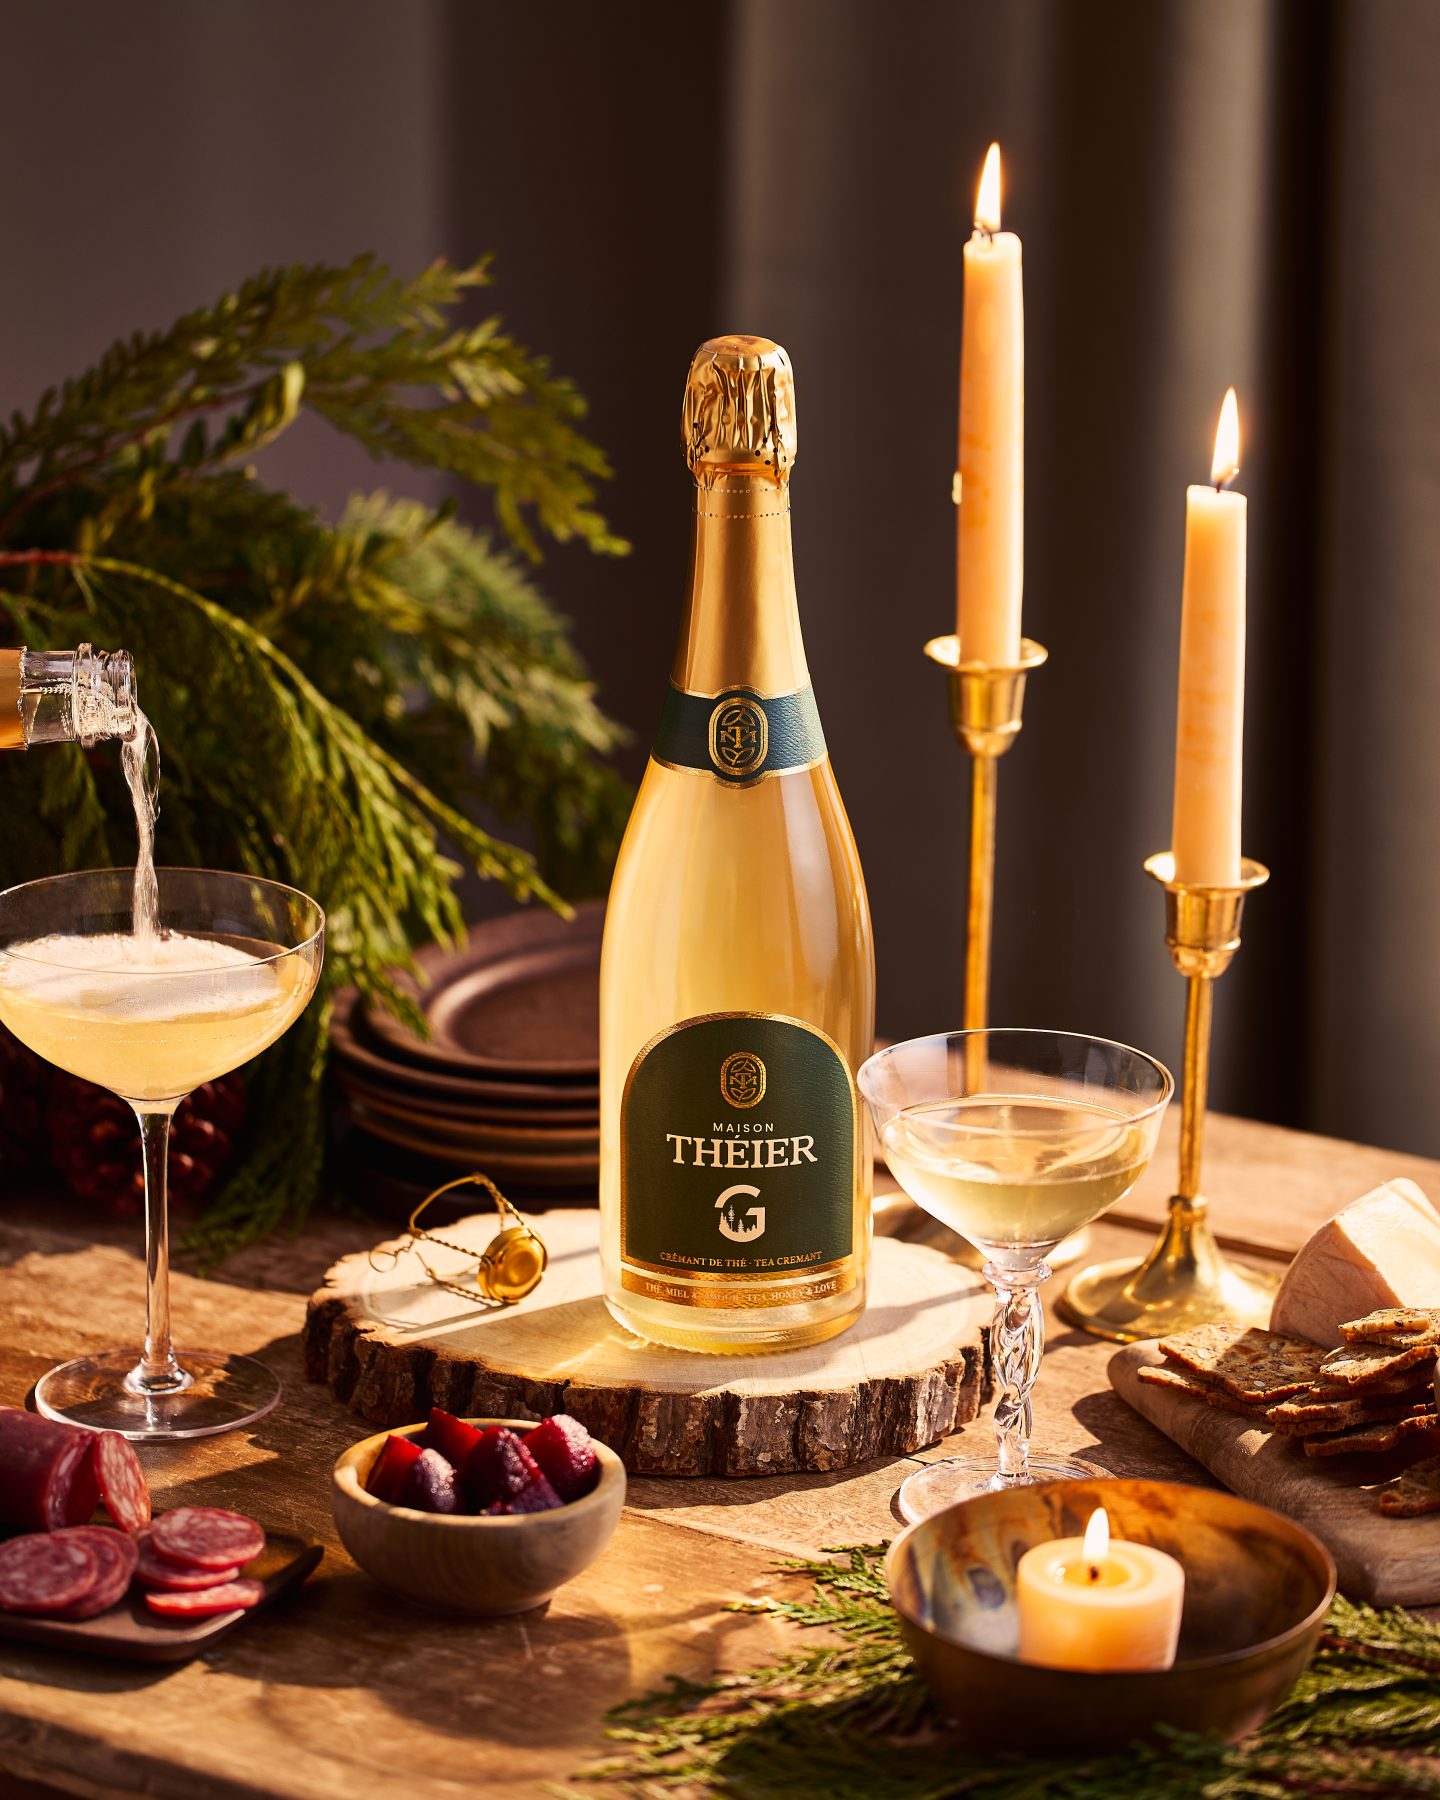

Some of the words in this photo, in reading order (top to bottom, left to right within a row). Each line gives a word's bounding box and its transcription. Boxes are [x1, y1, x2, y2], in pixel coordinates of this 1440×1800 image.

[713, 1122, 774, 1133] MAISON
[666, 1133, 818, 1169] THÉIER
[714, 1184, 766, 1243] G
[659, 1251, 707, 1265] CRÉMANT
[709, 1258, 723, 1267] DE
[725, 1257, 747, 1268] THÉ
[754, 1258, 775, 1267] TEA
[777, 1250, 823, 1266] CREMANT
[666, 1286, 690, 1299] MIEL
[815, 1280, 838, 1294] LOVE
